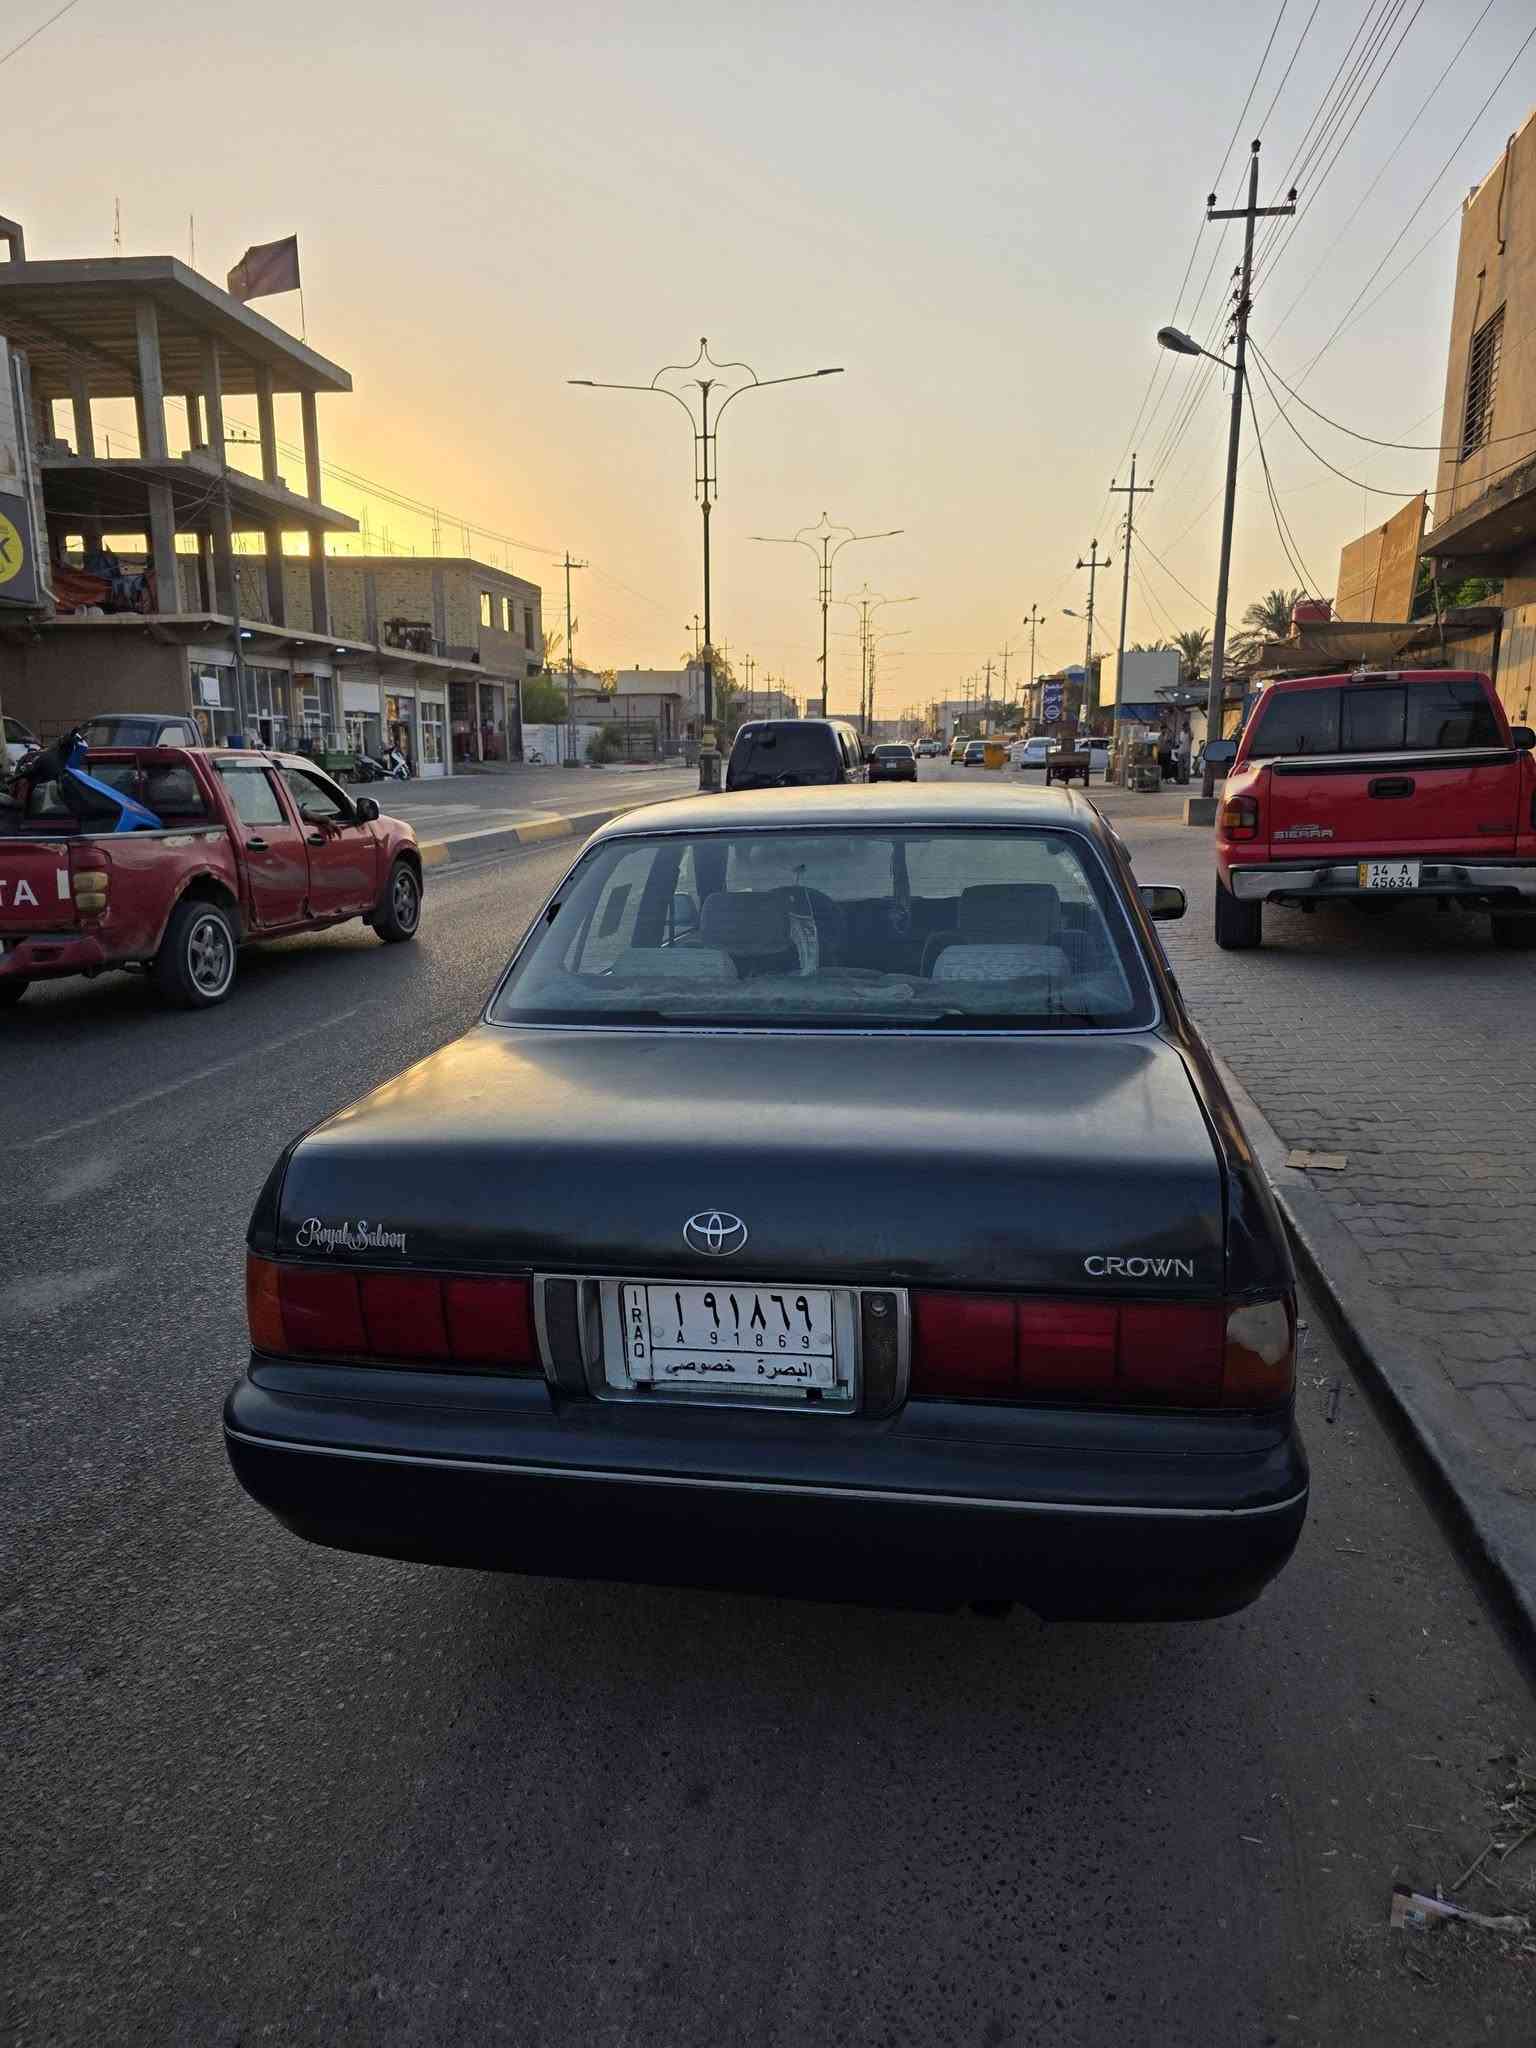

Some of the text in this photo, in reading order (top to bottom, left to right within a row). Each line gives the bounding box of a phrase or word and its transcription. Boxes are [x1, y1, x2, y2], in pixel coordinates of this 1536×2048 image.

[1372, 864, 1388, 876] 14
[1400, 864, 1409, 875] A
[1371, 876, 1413, 889] 45634
[296, 1217, 408, 1254] Royal Saloon
[1084, 1256, 1194, 1278] CROWN
[631, 1290, 645, 1358] IRAQ
[665, 1357, 813, 1382] البصرة خصوصي
